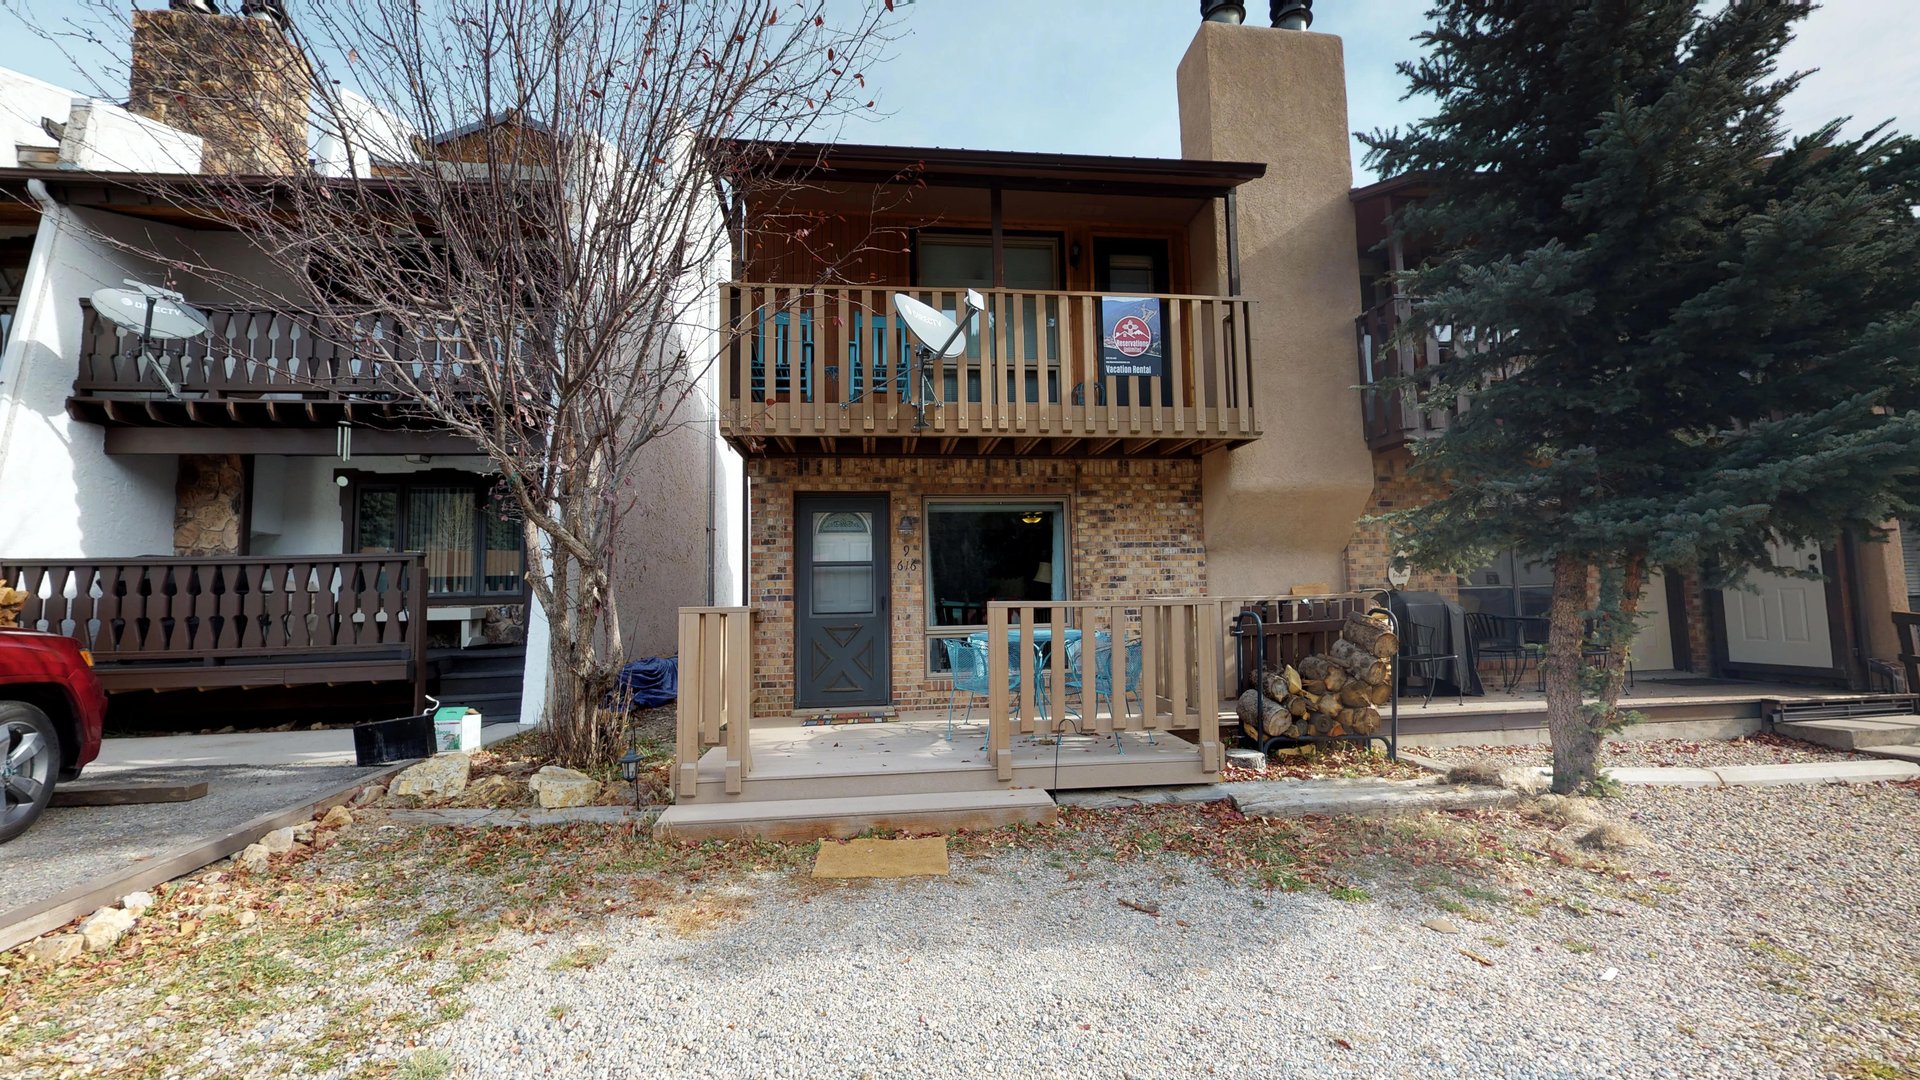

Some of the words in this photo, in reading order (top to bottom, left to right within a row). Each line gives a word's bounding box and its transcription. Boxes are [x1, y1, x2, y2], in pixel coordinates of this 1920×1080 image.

[134, 301, 181, 316] DIECTV
[1116, 339, 1149, 347] Reservations
[1105, 365, 1132, 374] Vacation
[1132, 365, 1152, 374] Rental
[903, 545, 910, 557] 9
[897, 560, 917, 571] 616
